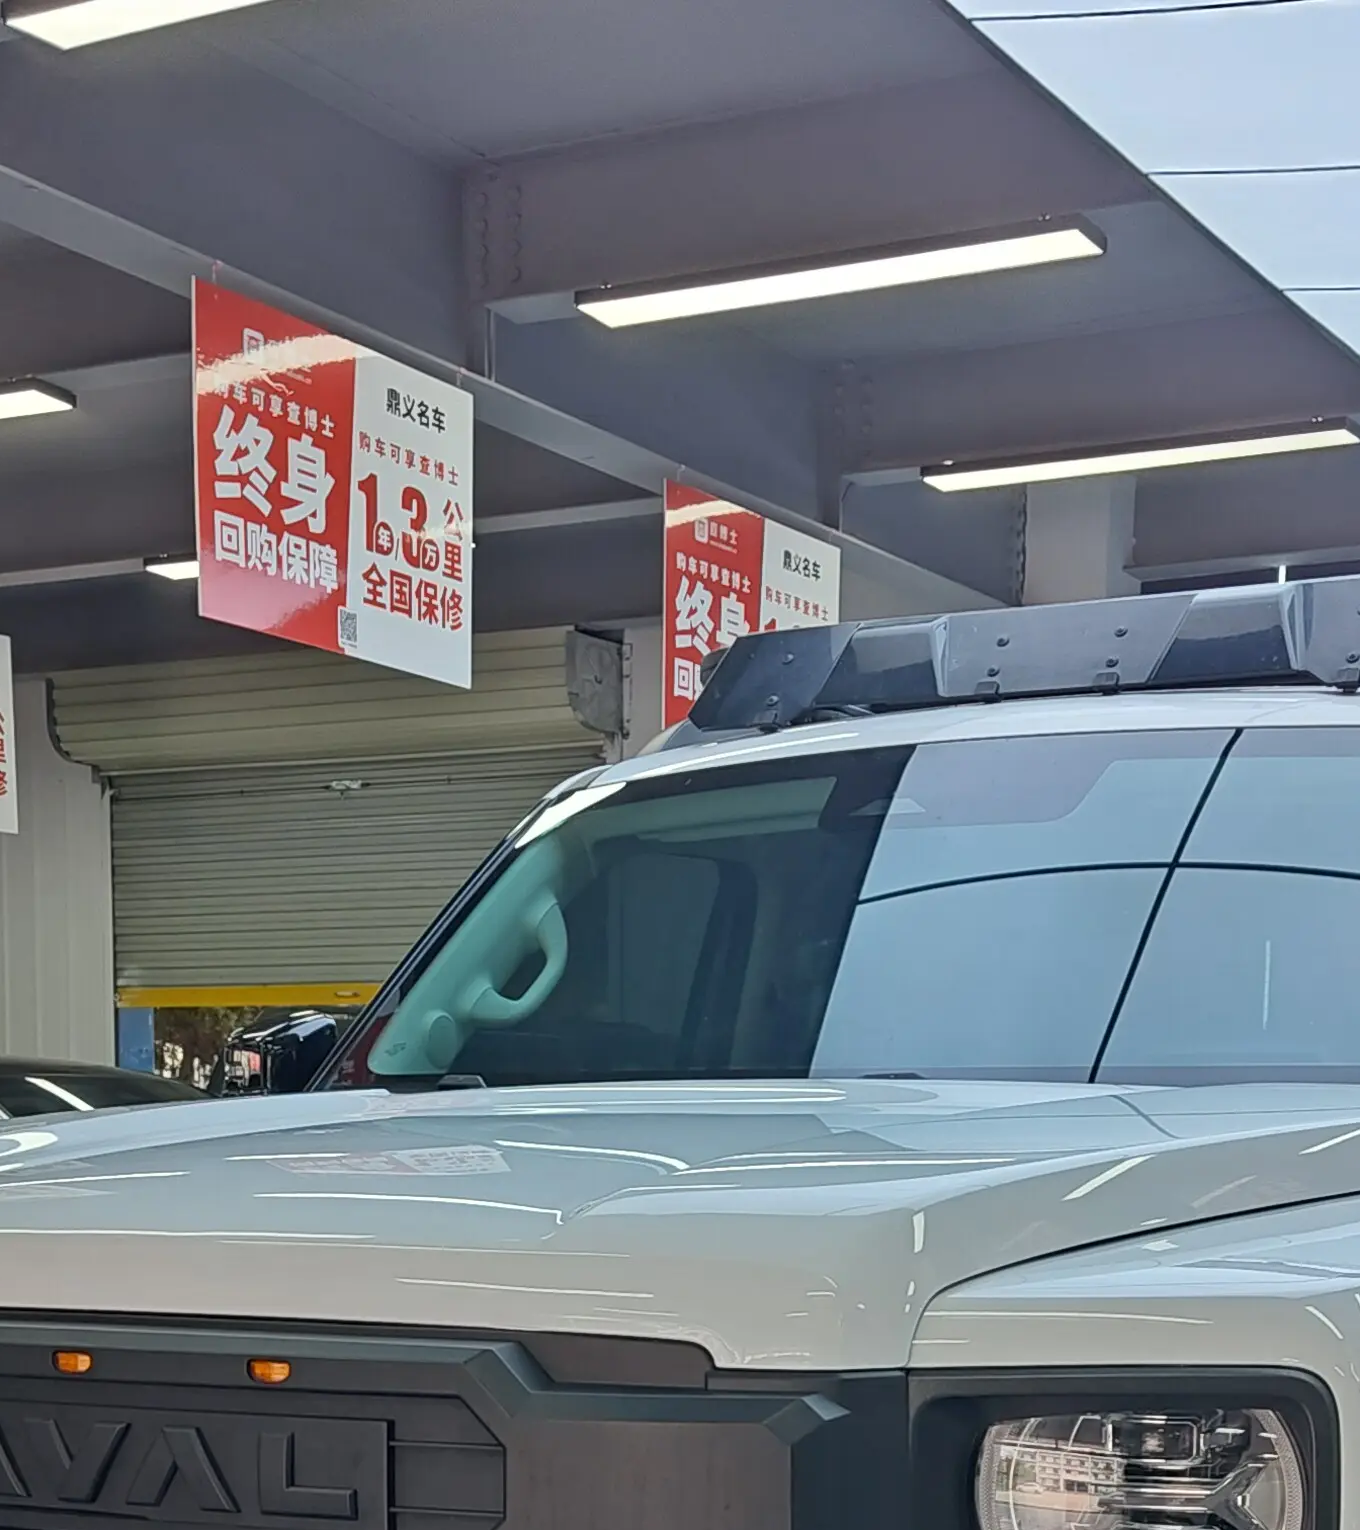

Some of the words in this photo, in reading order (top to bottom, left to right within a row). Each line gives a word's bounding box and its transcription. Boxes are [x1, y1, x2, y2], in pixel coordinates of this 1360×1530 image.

[386, 388, 446, 433] 鼎义名车
[213, 404, 335, 534] 终身
[358, 431, 459, 486] 购车可享查博士
[214, 509, 338, 594] 回购保障
[362, 562, 463, 632] 全国保修
[674, 575, 751, 657] 终身
